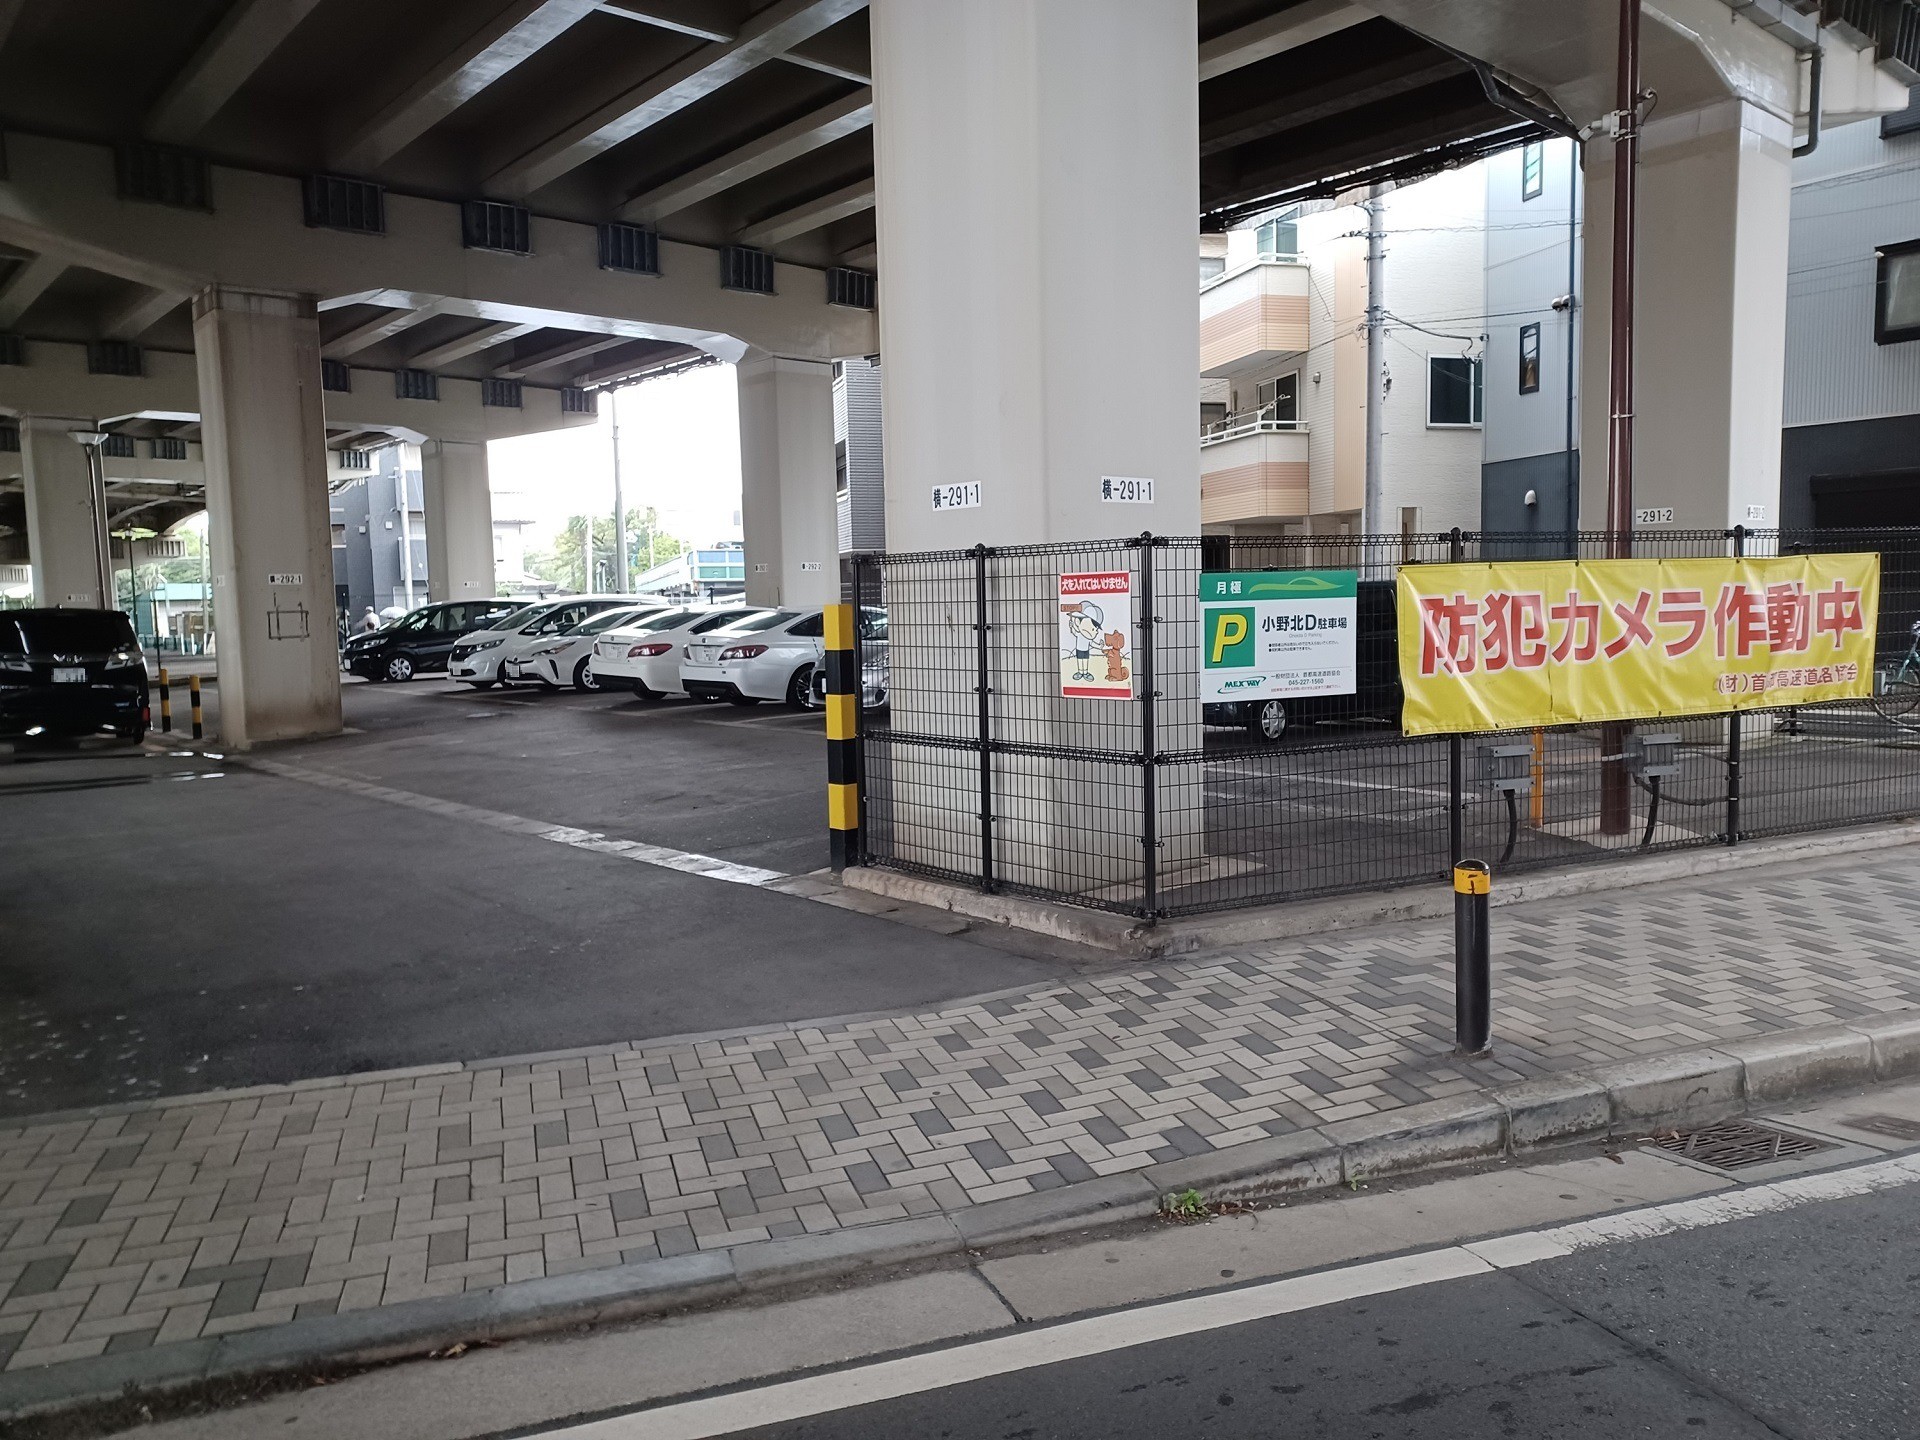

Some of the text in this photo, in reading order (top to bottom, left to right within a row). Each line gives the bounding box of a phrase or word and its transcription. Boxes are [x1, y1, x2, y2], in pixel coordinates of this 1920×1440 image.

[1061, 576, 1128, 592] 犬を入れてはいけません
[1216, 581, 1242, 594] 月極
[1262, 614, 1348, 632] 小野北D駐車場
[1418, 579, 1864, 676] 防犯カメラ作動中
[1212, 614, 1248, 663] P
